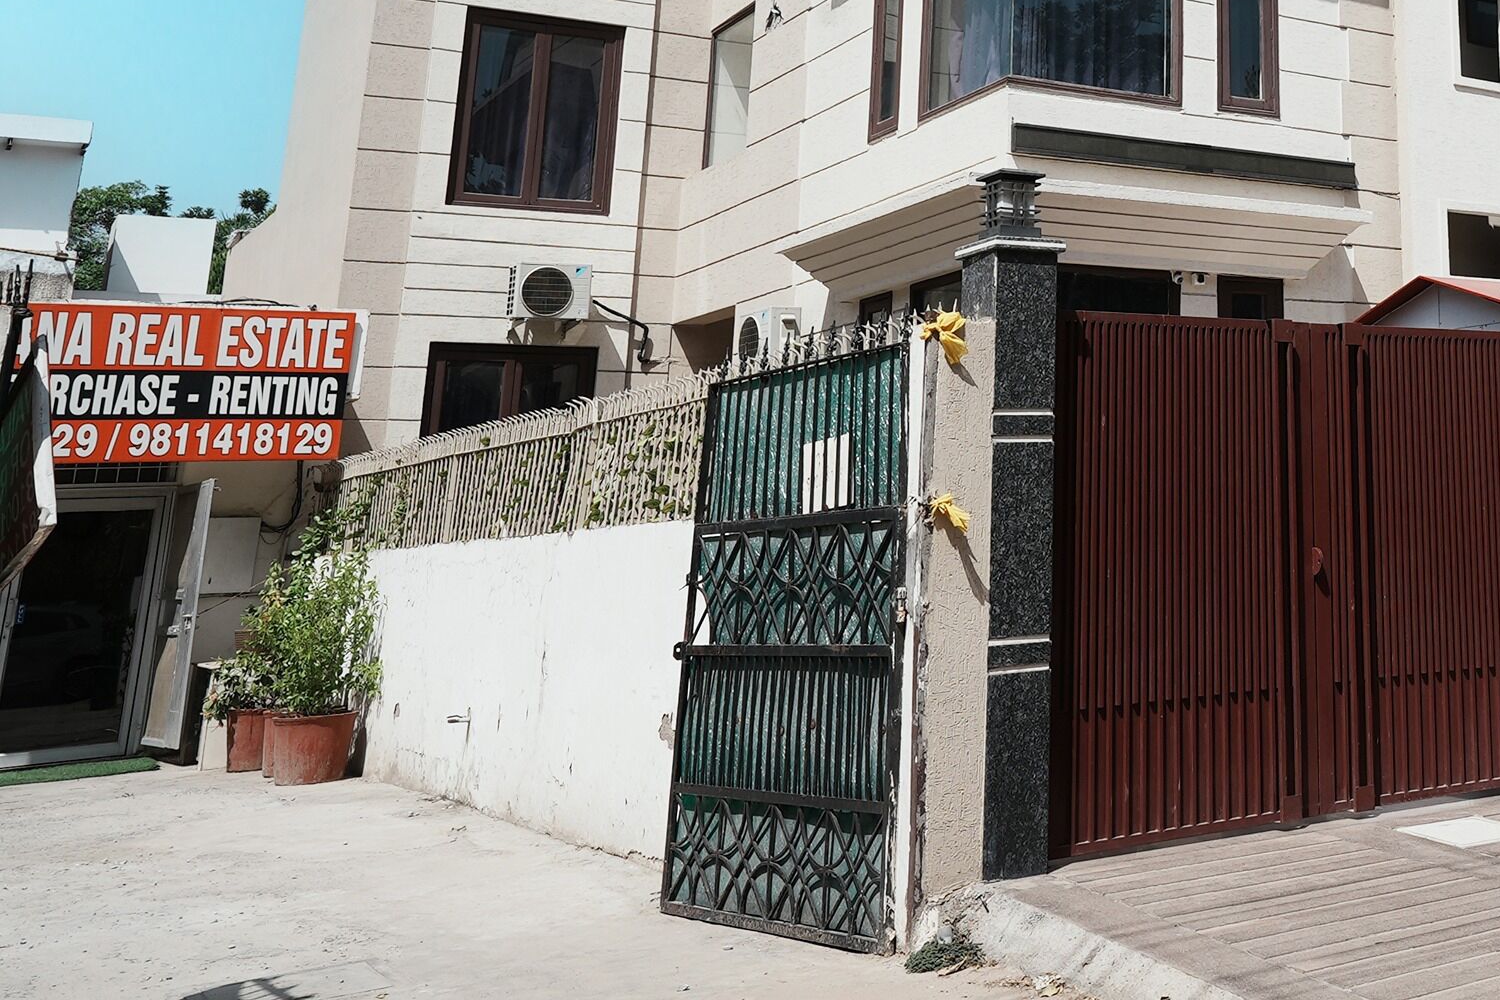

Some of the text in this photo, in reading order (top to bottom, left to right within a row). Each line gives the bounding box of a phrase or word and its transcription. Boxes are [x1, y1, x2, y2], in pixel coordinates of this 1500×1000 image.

[105, 313, 204, 366] REAL
[216, 316, 349, 369] ESTATE
[11, 374, 180, 415] RCHASE
[208, 375, 339, 416] RENTING
[129, 422, 333, 455] 9811418129
